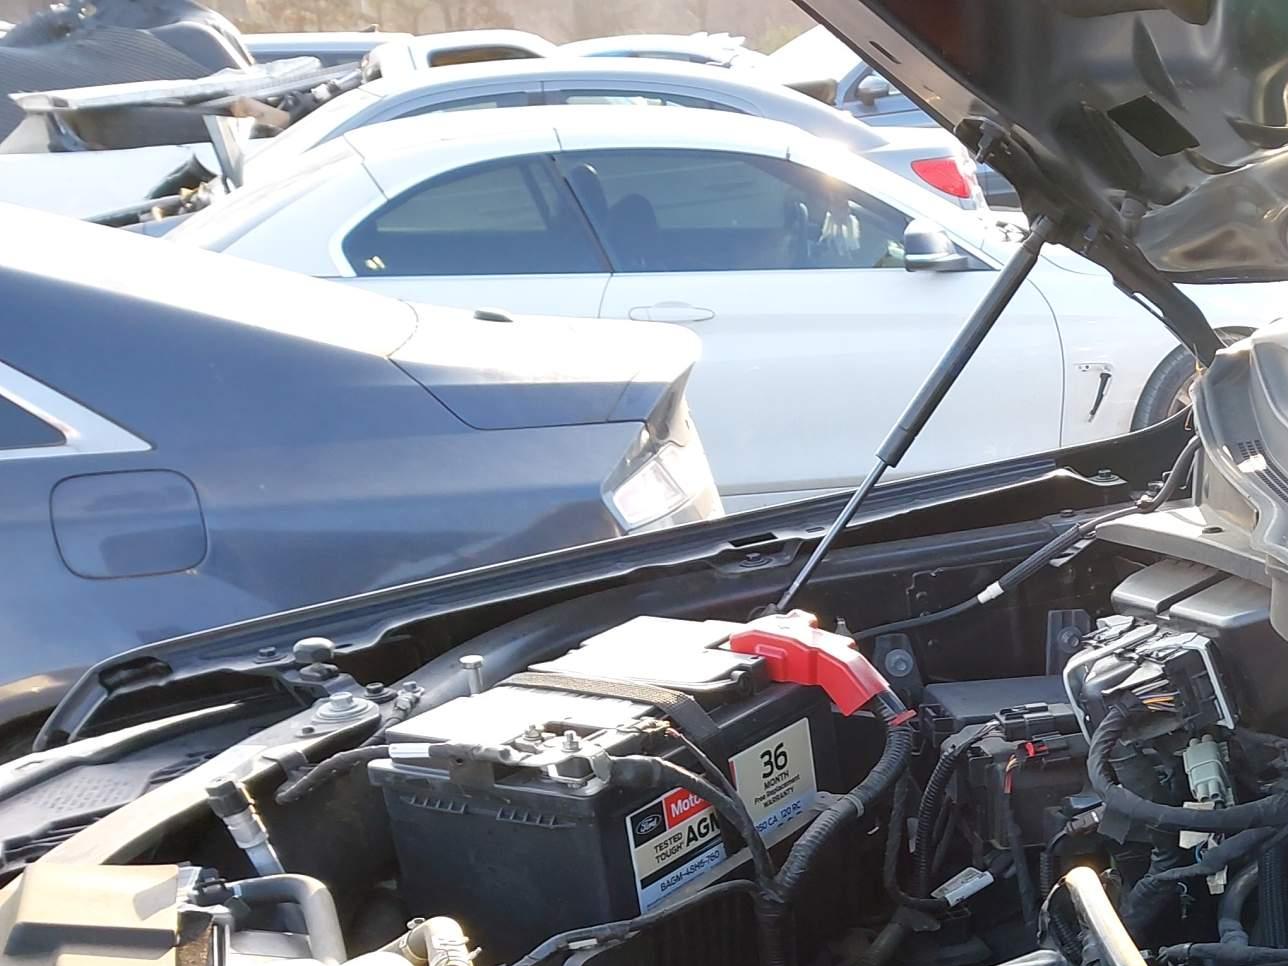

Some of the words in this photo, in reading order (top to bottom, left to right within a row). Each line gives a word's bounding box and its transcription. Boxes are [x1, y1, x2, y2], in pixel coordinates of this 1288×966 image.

[759, 741, 789, 779] 36
[763, 770, 789, 790] MONTH
[670, 793, 704, 818] Moto
[653, 831, 683, 854] TESTED
